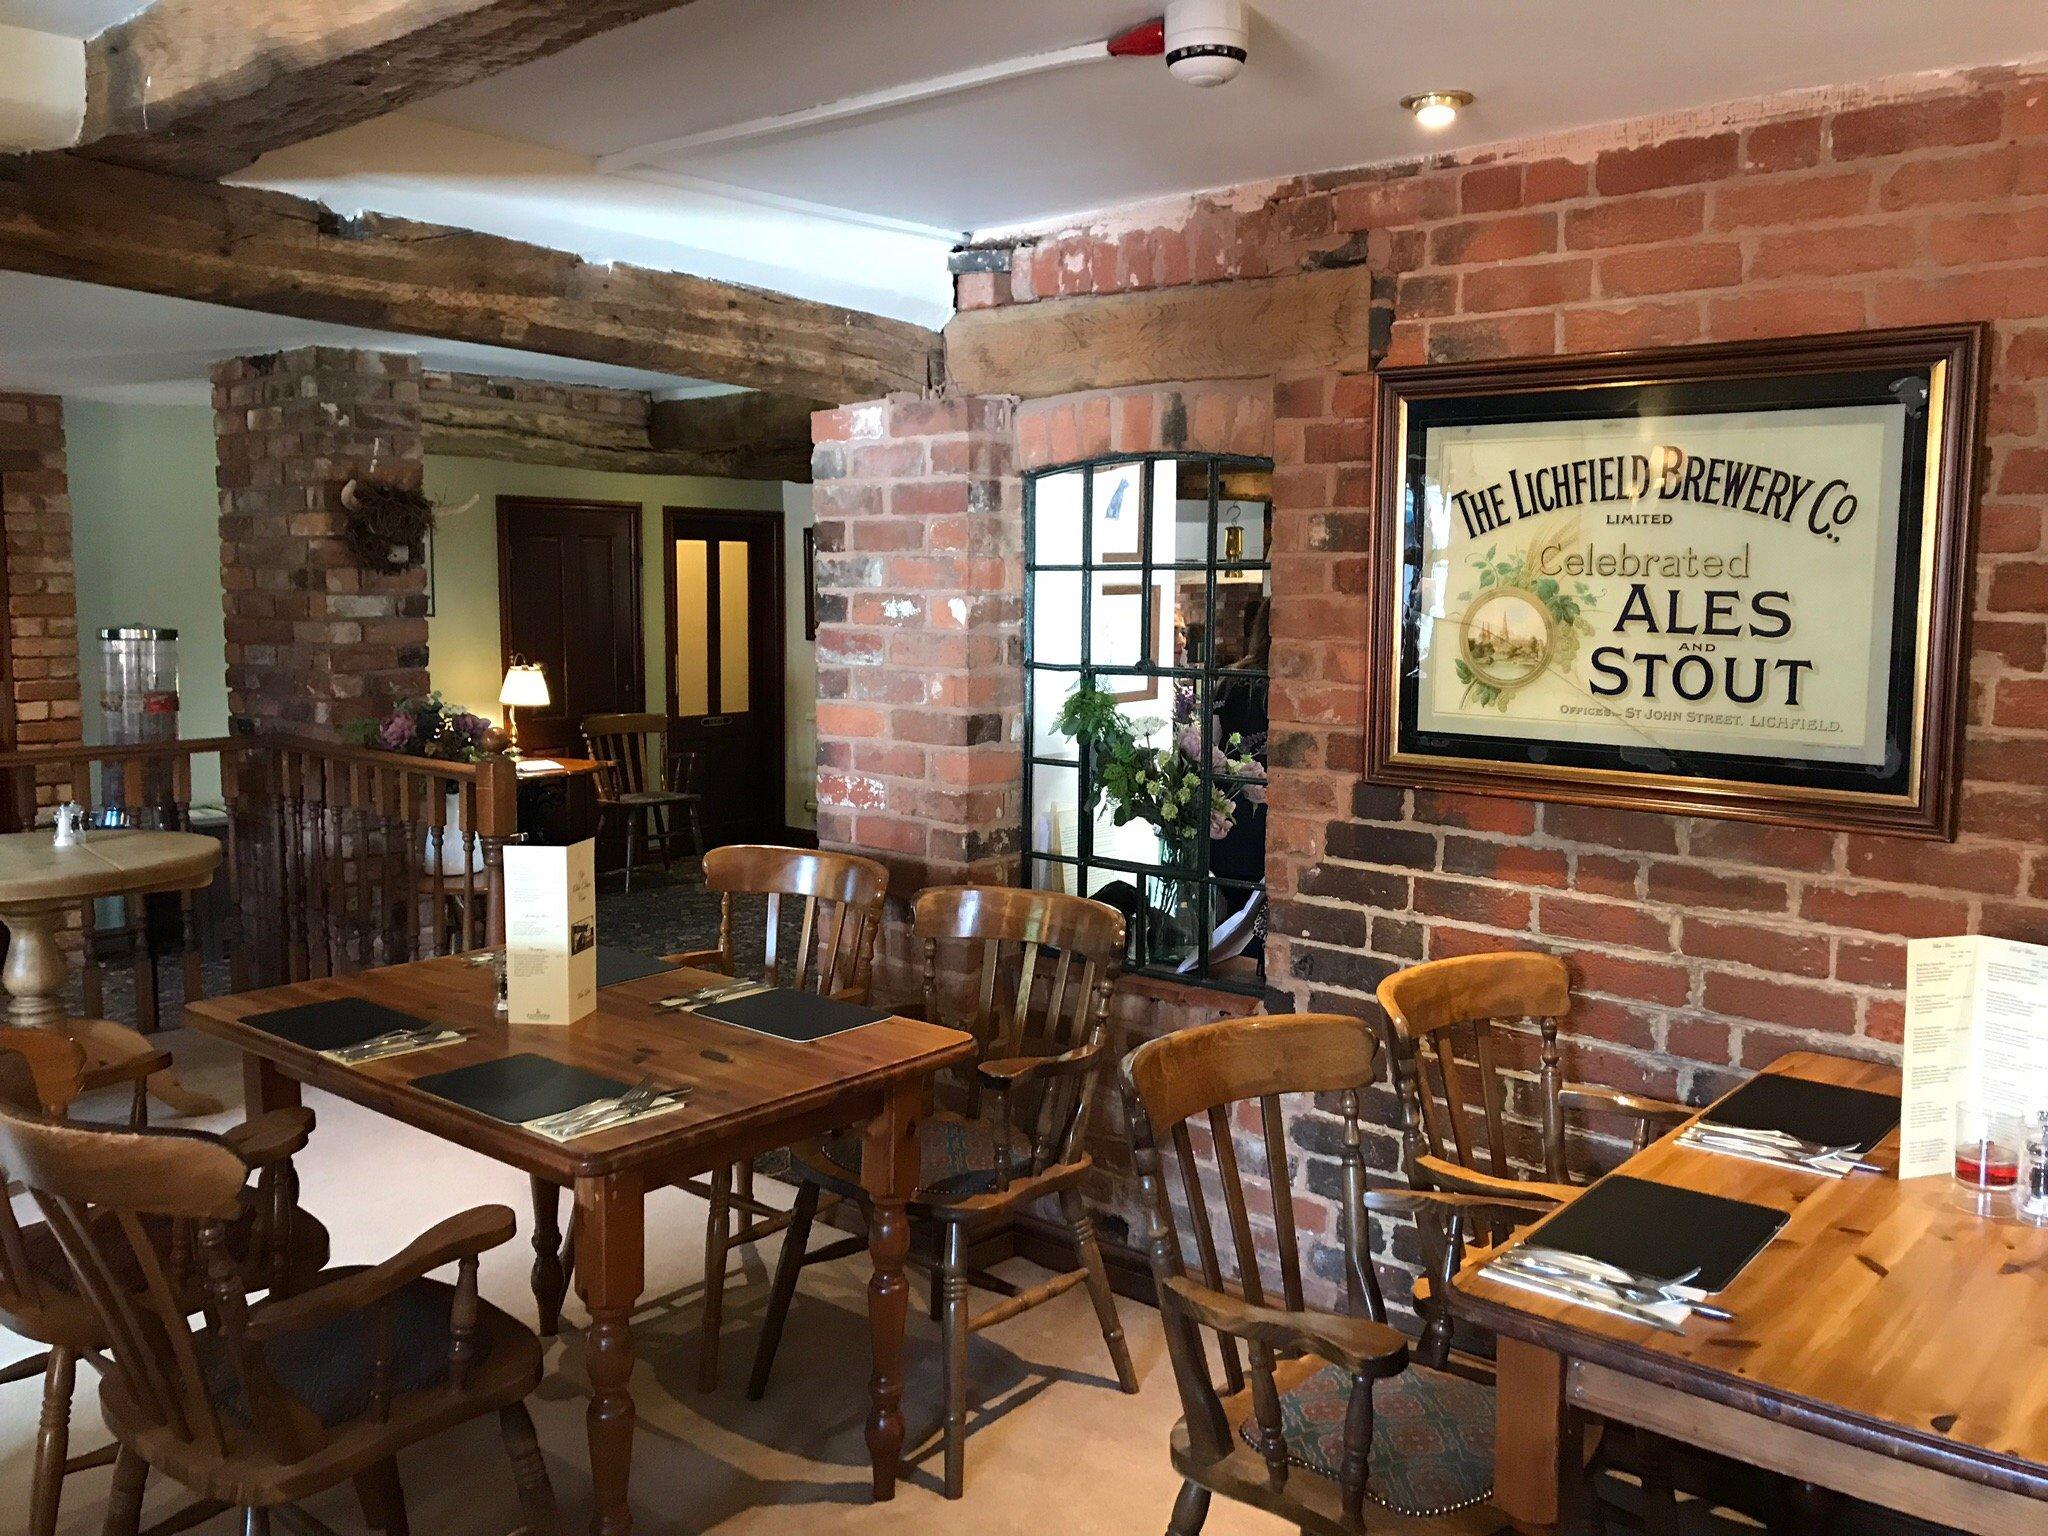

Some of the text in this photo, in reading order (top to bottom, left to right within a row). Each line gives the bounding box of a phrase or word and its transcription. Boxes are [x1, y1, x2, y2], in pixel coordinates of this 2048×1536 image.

[1451, 483, 1511, 539] THE
[1508, 454, 1650, 520] LICHFIELD
[1658, 445, 1816, 523] BREWERY
[1606, 514, 1673, 525] LIMITED
[1540, 542, 1750, 578] Celebrated
[1612, 583, 1792, 638] ALES
[1678, 642, 1716, 652] AND
[1588, 646, 1814, 706] STOUT
[1644, 709, 1682, 721] JOHN
